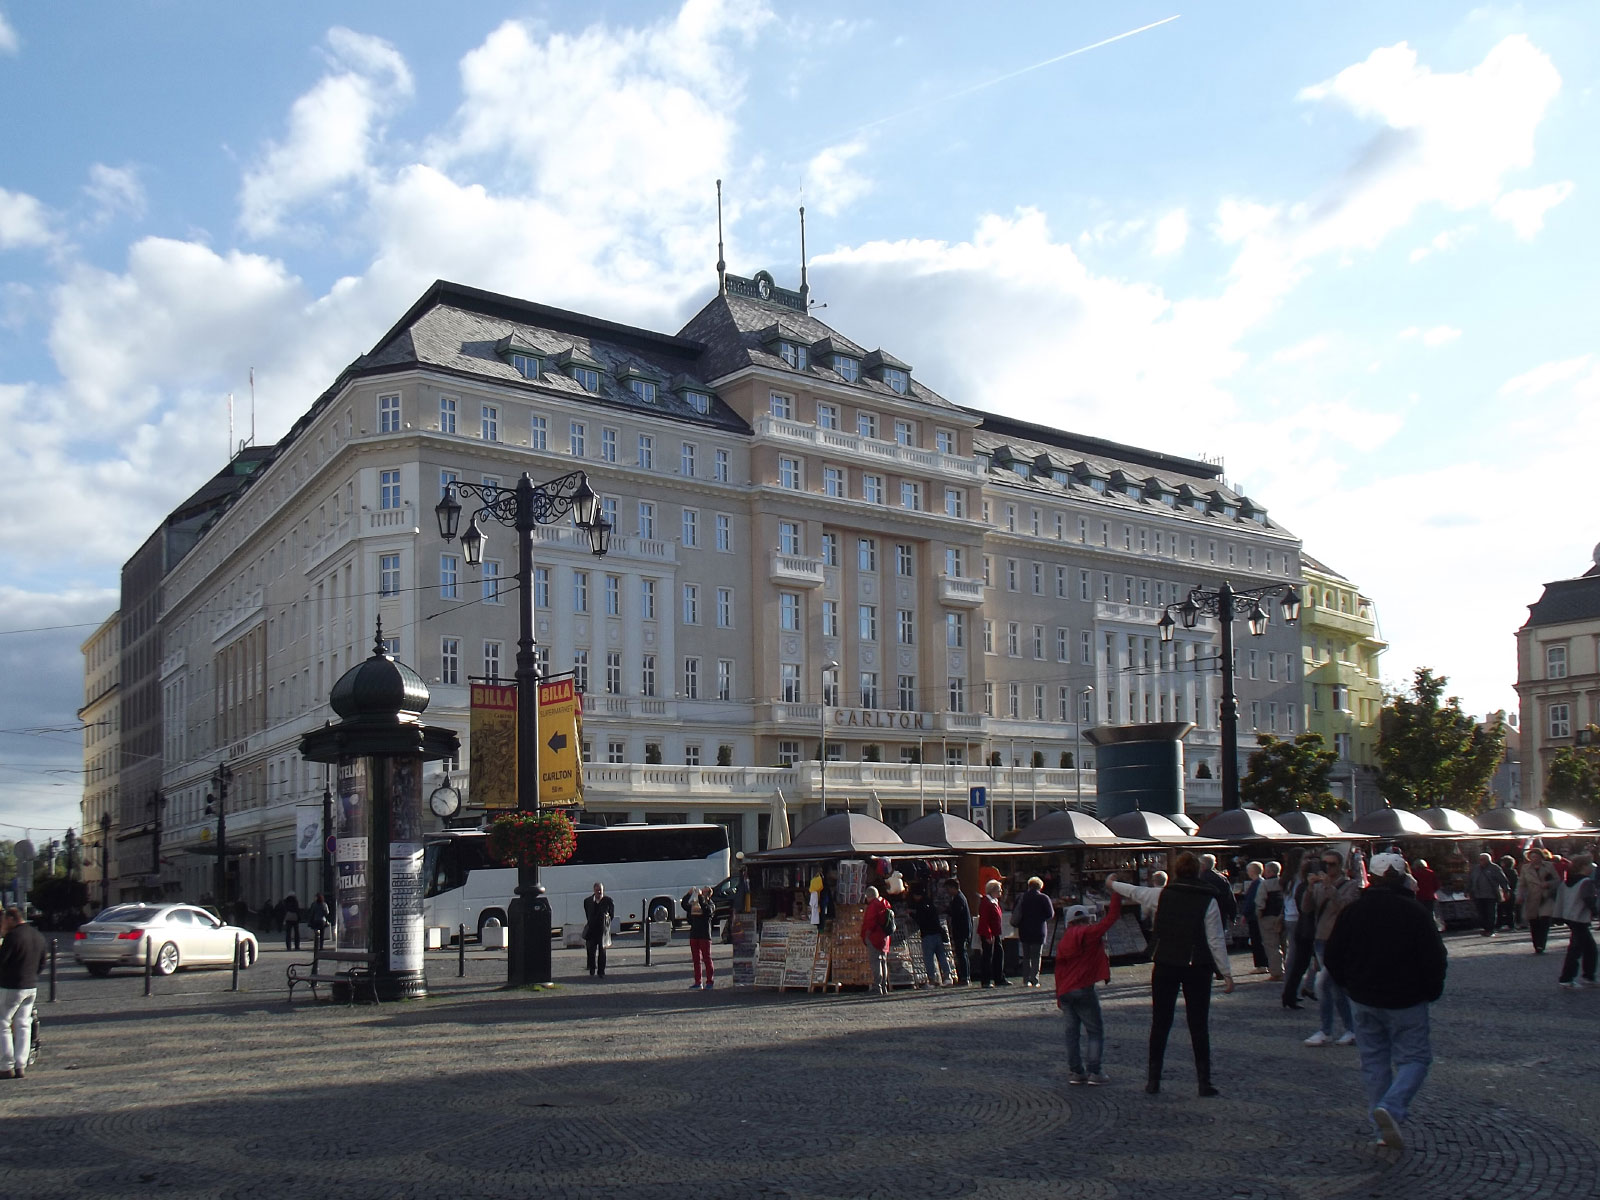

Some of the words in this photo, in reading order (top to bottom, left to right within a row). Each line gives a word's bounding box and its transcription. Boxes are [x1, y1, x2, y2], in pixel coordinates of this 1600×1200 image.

[474, 688, 513, 707] BILLA
[542, 683, 571, 703] BILLA
[834, 708, 924, 730] CARLTON
[543, 770, 572, 782] CARLTON
